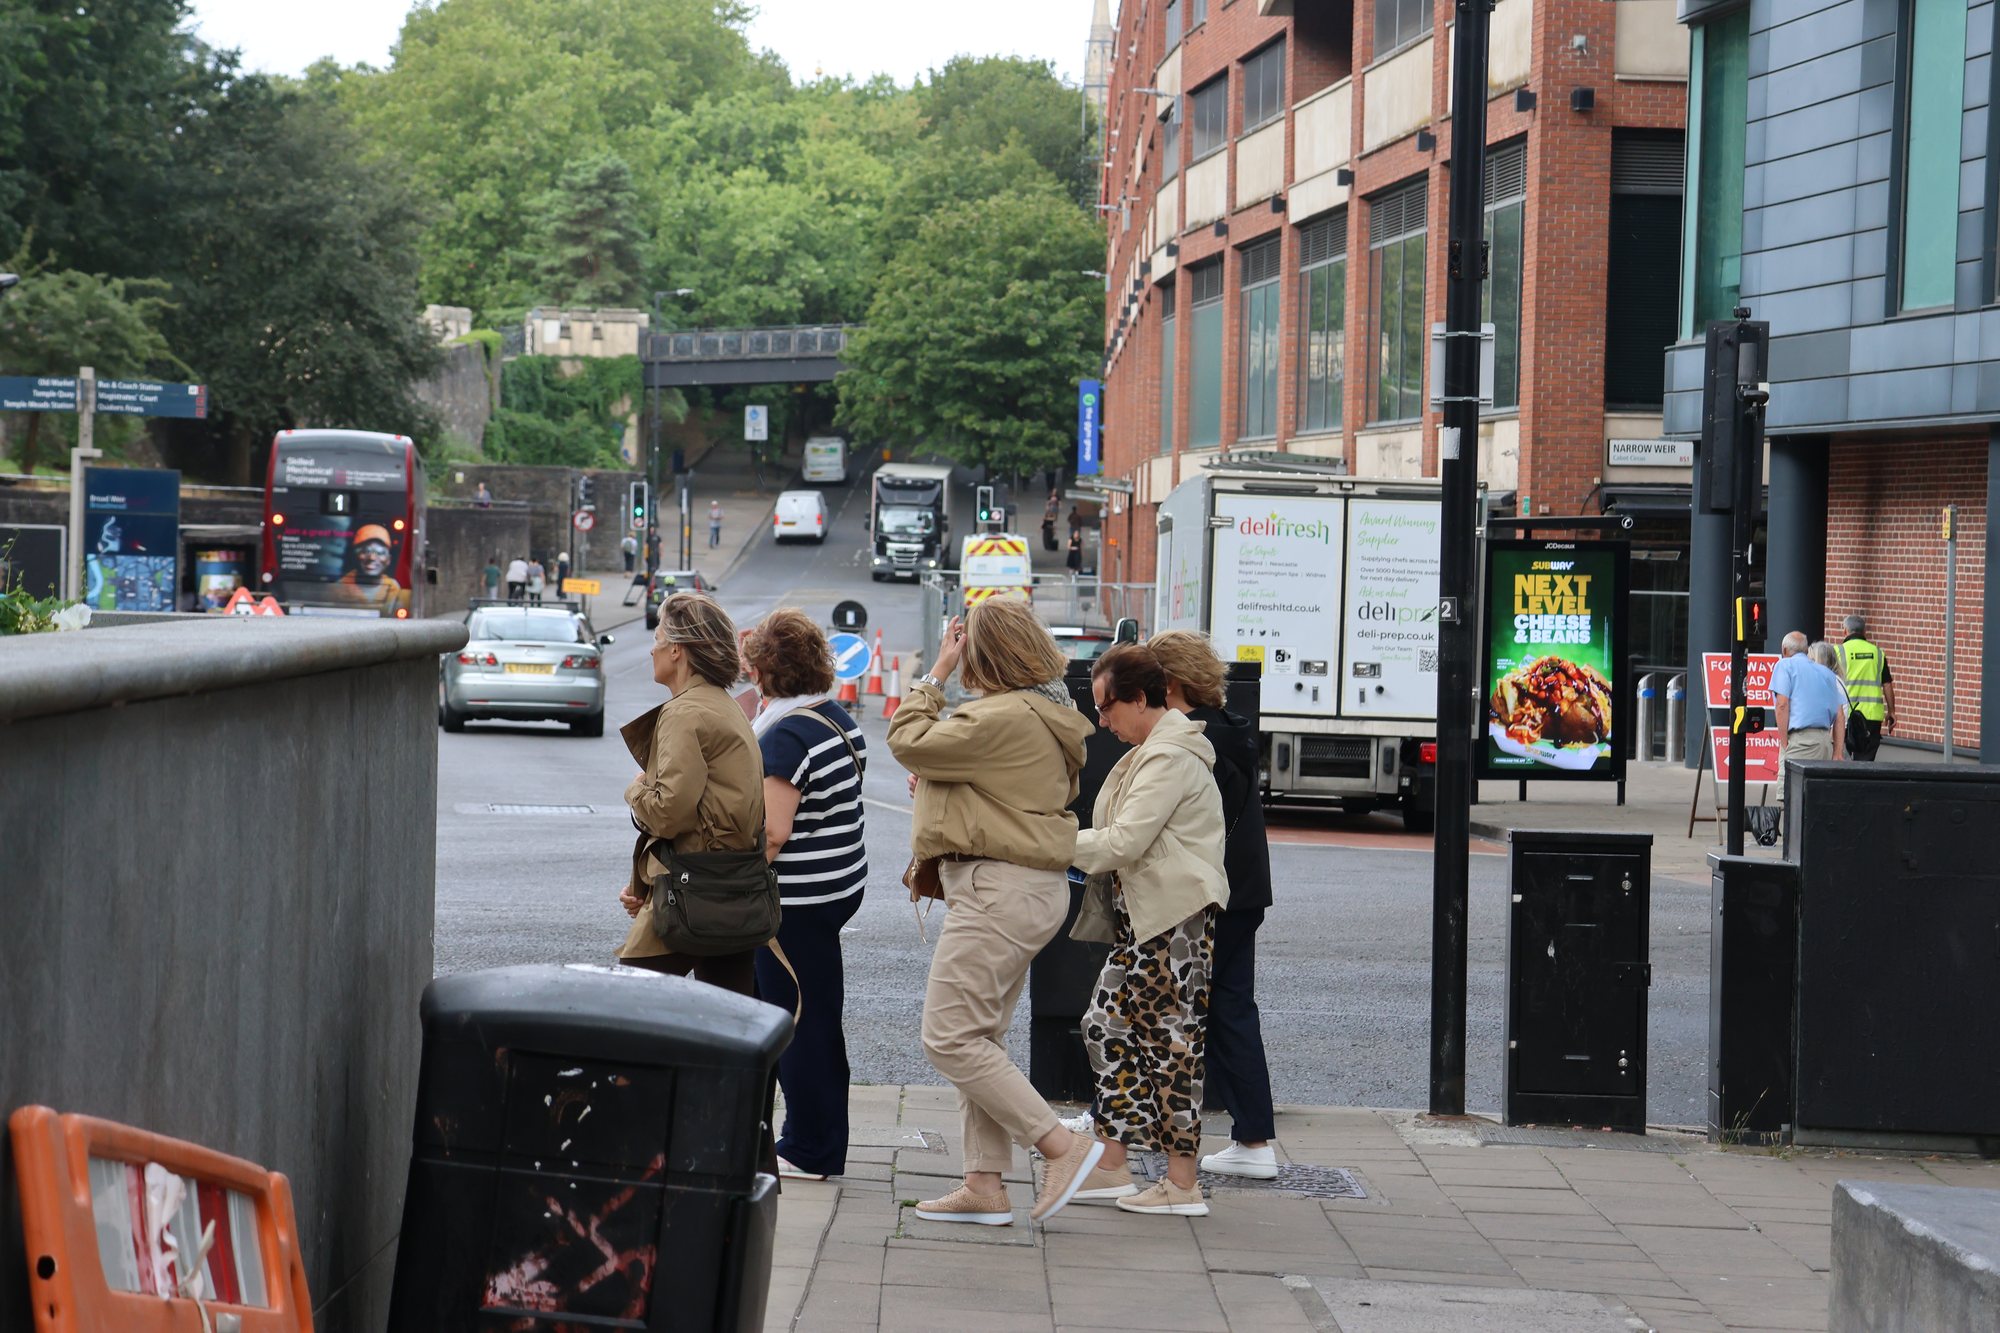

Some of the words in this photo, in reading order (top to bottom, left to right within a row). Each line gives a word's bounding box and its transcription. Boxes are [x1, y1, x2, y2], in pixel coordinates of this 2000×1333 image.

[140, 383, 163, 392] Station
[1613, 444, 1652, 454] NARROW
[1654, 444, 1676, 454] WEIR
[335, 494, 344, 512] 1
[1240, 510, 1329, 544] delifresh
[1360, 512, 1392, 528] Award
[1393, 514, 1436, 534] Winning
[1357, 530, 1399, 550] Supplier
[1532, 561, 1574, 570] SUBWAY
[1359, 585, 1374, 598] Ask
[1375, 590, 1384, 598] us
[1386, 586, 1408, 598] about
[1514, 574, 1592, 596] NEXT
[1237, 602, 1320, 612] delifreshltd.co.uk
[1441, 601, 1452, 618] 2
[1514, 596, 1592, 614] LEVEL
[1358, 600, 1439, 626] delipre
[1514, 614, 1591, 630] CHEESE
[1358, 629, 1434, 641] deli-prep.co.uk
[1514, 630, 1528, 644] &
[1530, 630, 1590, 644] BEANS
[1710, 660, 1774, 672] FOWAY
[1724, 675, 1766, 686] AAD
[1721, 689, 1771, 700] CSED
[1716, 737, 1780, 748] PESTRIAN
